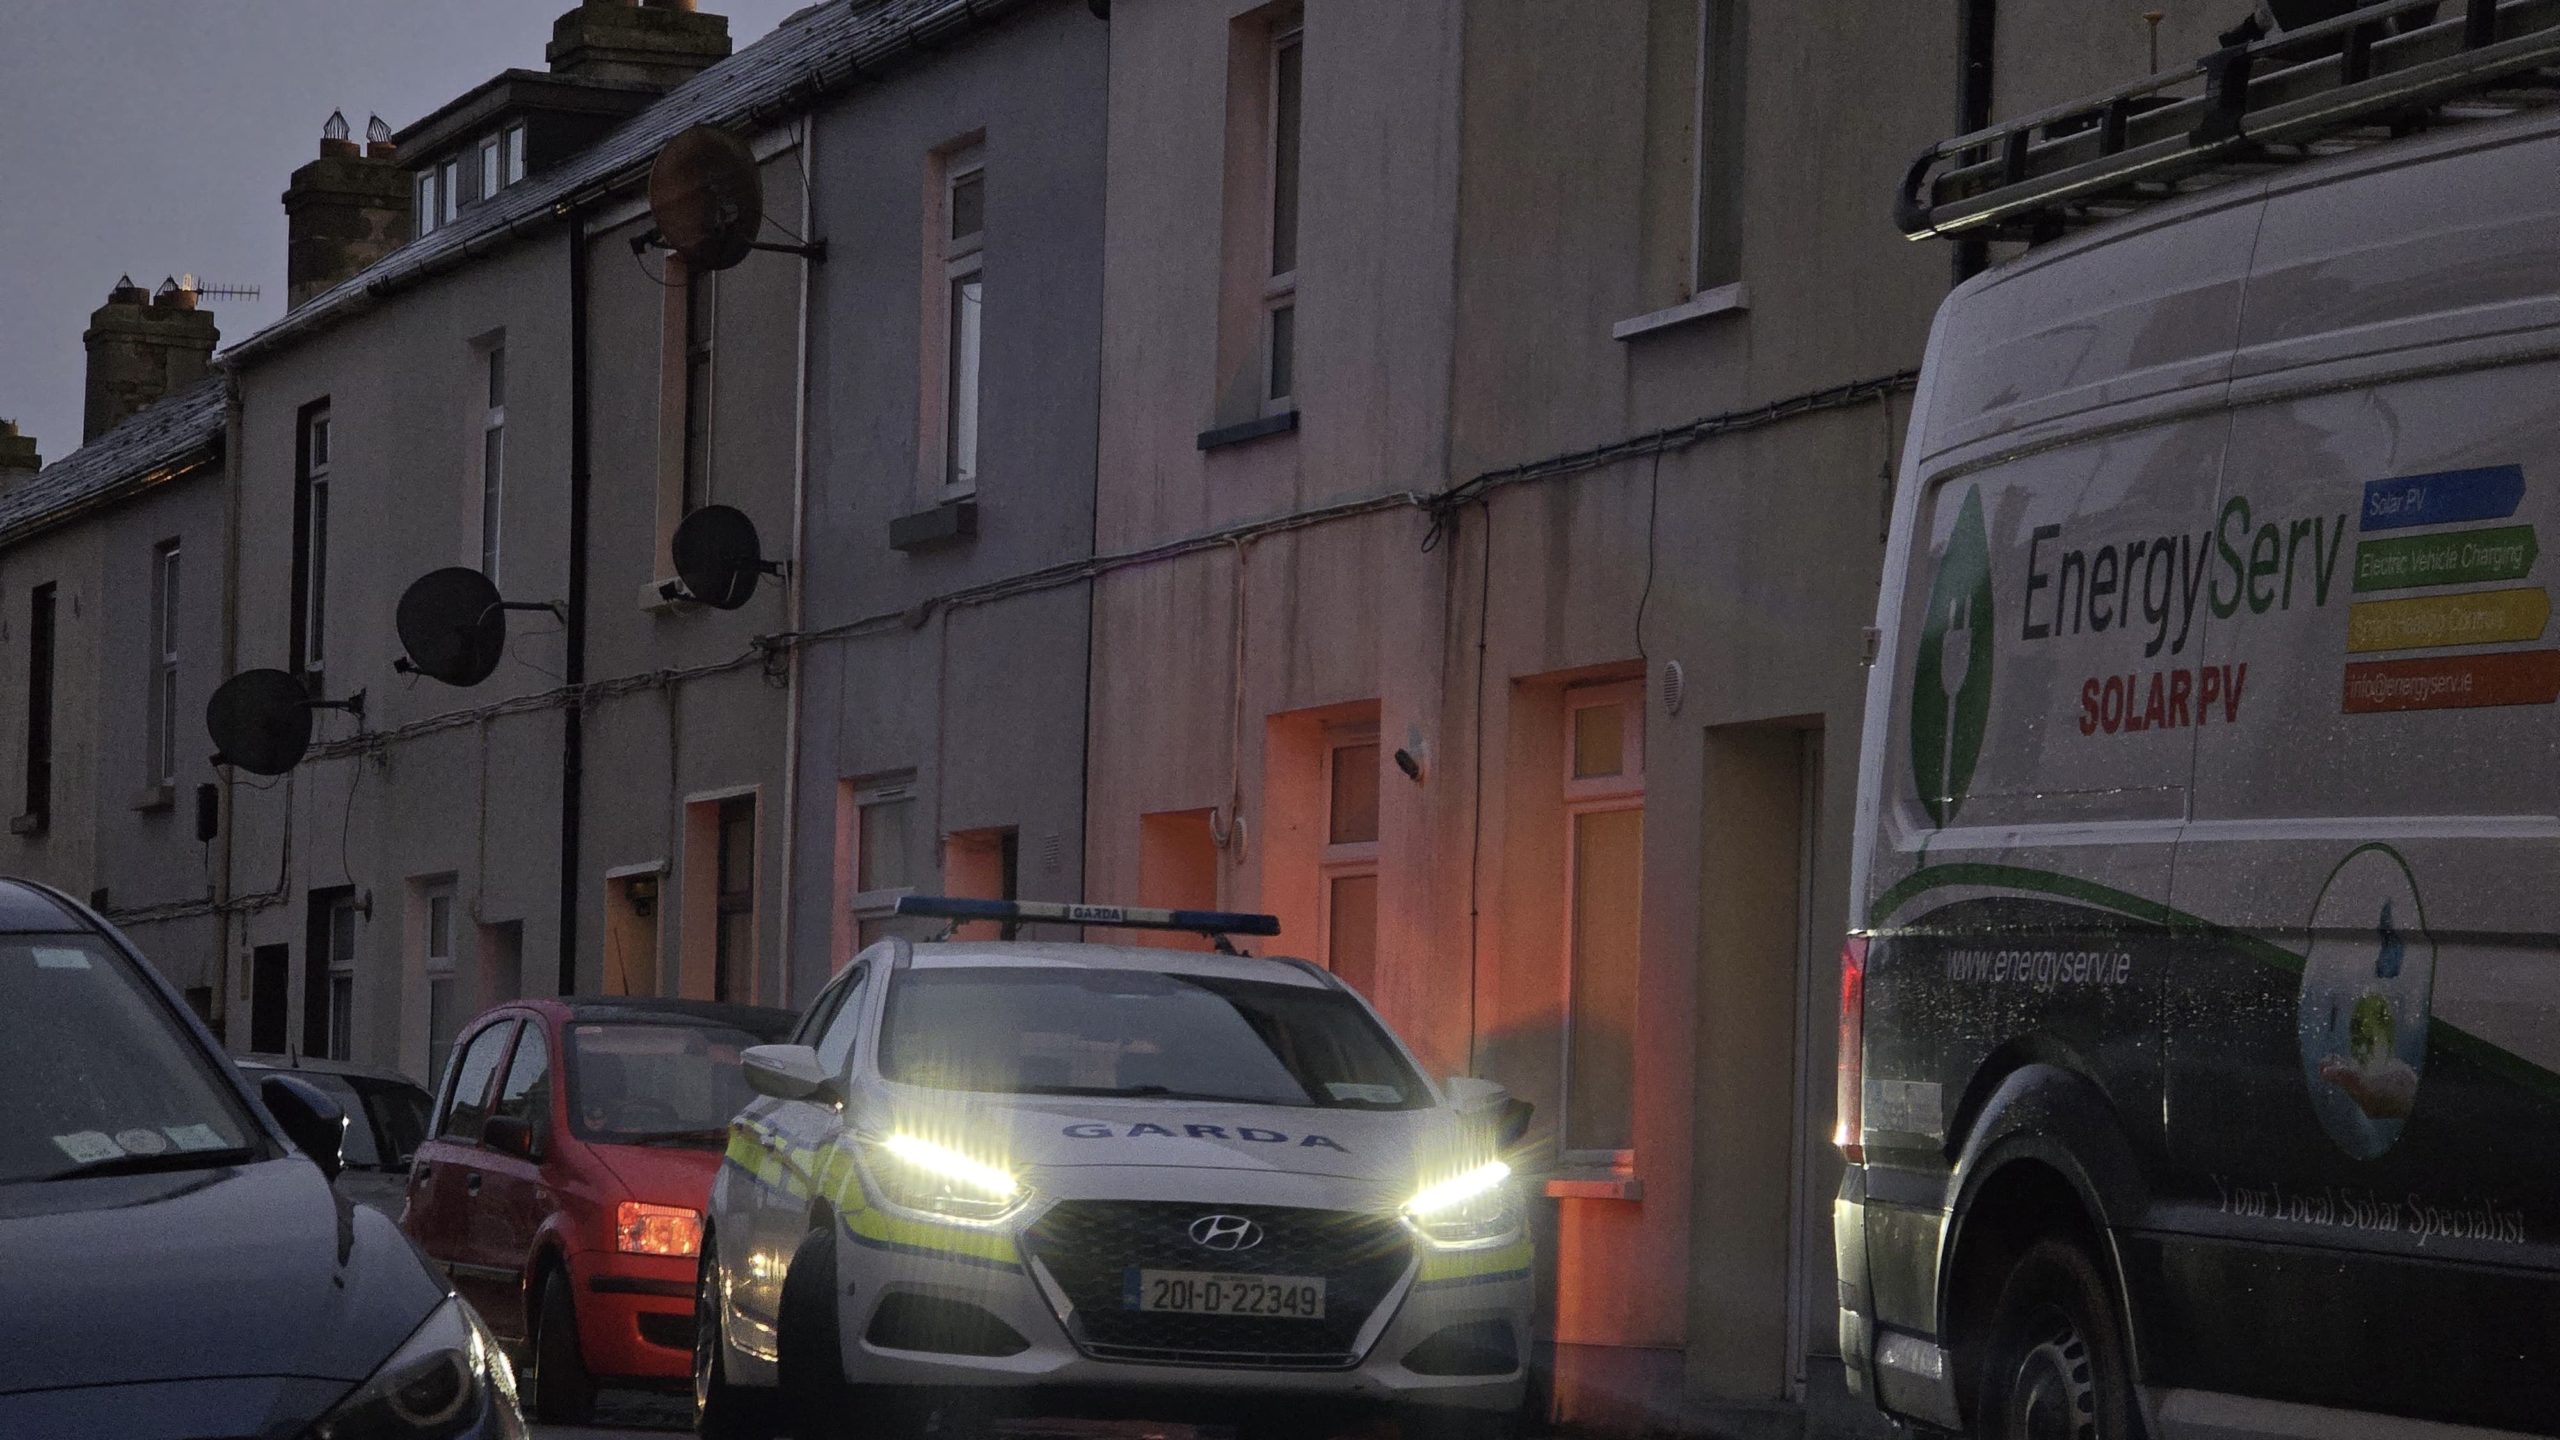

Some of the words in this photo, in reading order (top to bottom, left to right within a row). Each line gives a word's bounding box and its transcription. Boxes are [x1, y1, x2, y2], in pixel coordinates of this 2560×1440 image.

[2369, 493, 2403, 517] Solar
[2404, 487, 2427, 512] PV
[2021, 495, 2347, 659] EnergyServ
[2361, 552, 2408, 578] Electric
[2411, 547, 2458, 572] Vehicle
[2461, 541, 2525, 571] Charging
[2079, 668, 2192, 736] SOLAR
[2197, 662, 2248, 726] PV
[1073, 906, 1120, 920] GARDA
[1947, 949, 2131, 993] www.energyserv.ie
[1062, 1122, 1352, 1154] GARDA
[2209, 1173, 2269, 1218] Your
[2271, 1181, 2335, 1226] Local
[2341, 1186, 2402, 1232] Solar
[2406, 1191, 2526, 1247] Specialist
[1153, 1279, 1317, 1317] 201-D-22349
